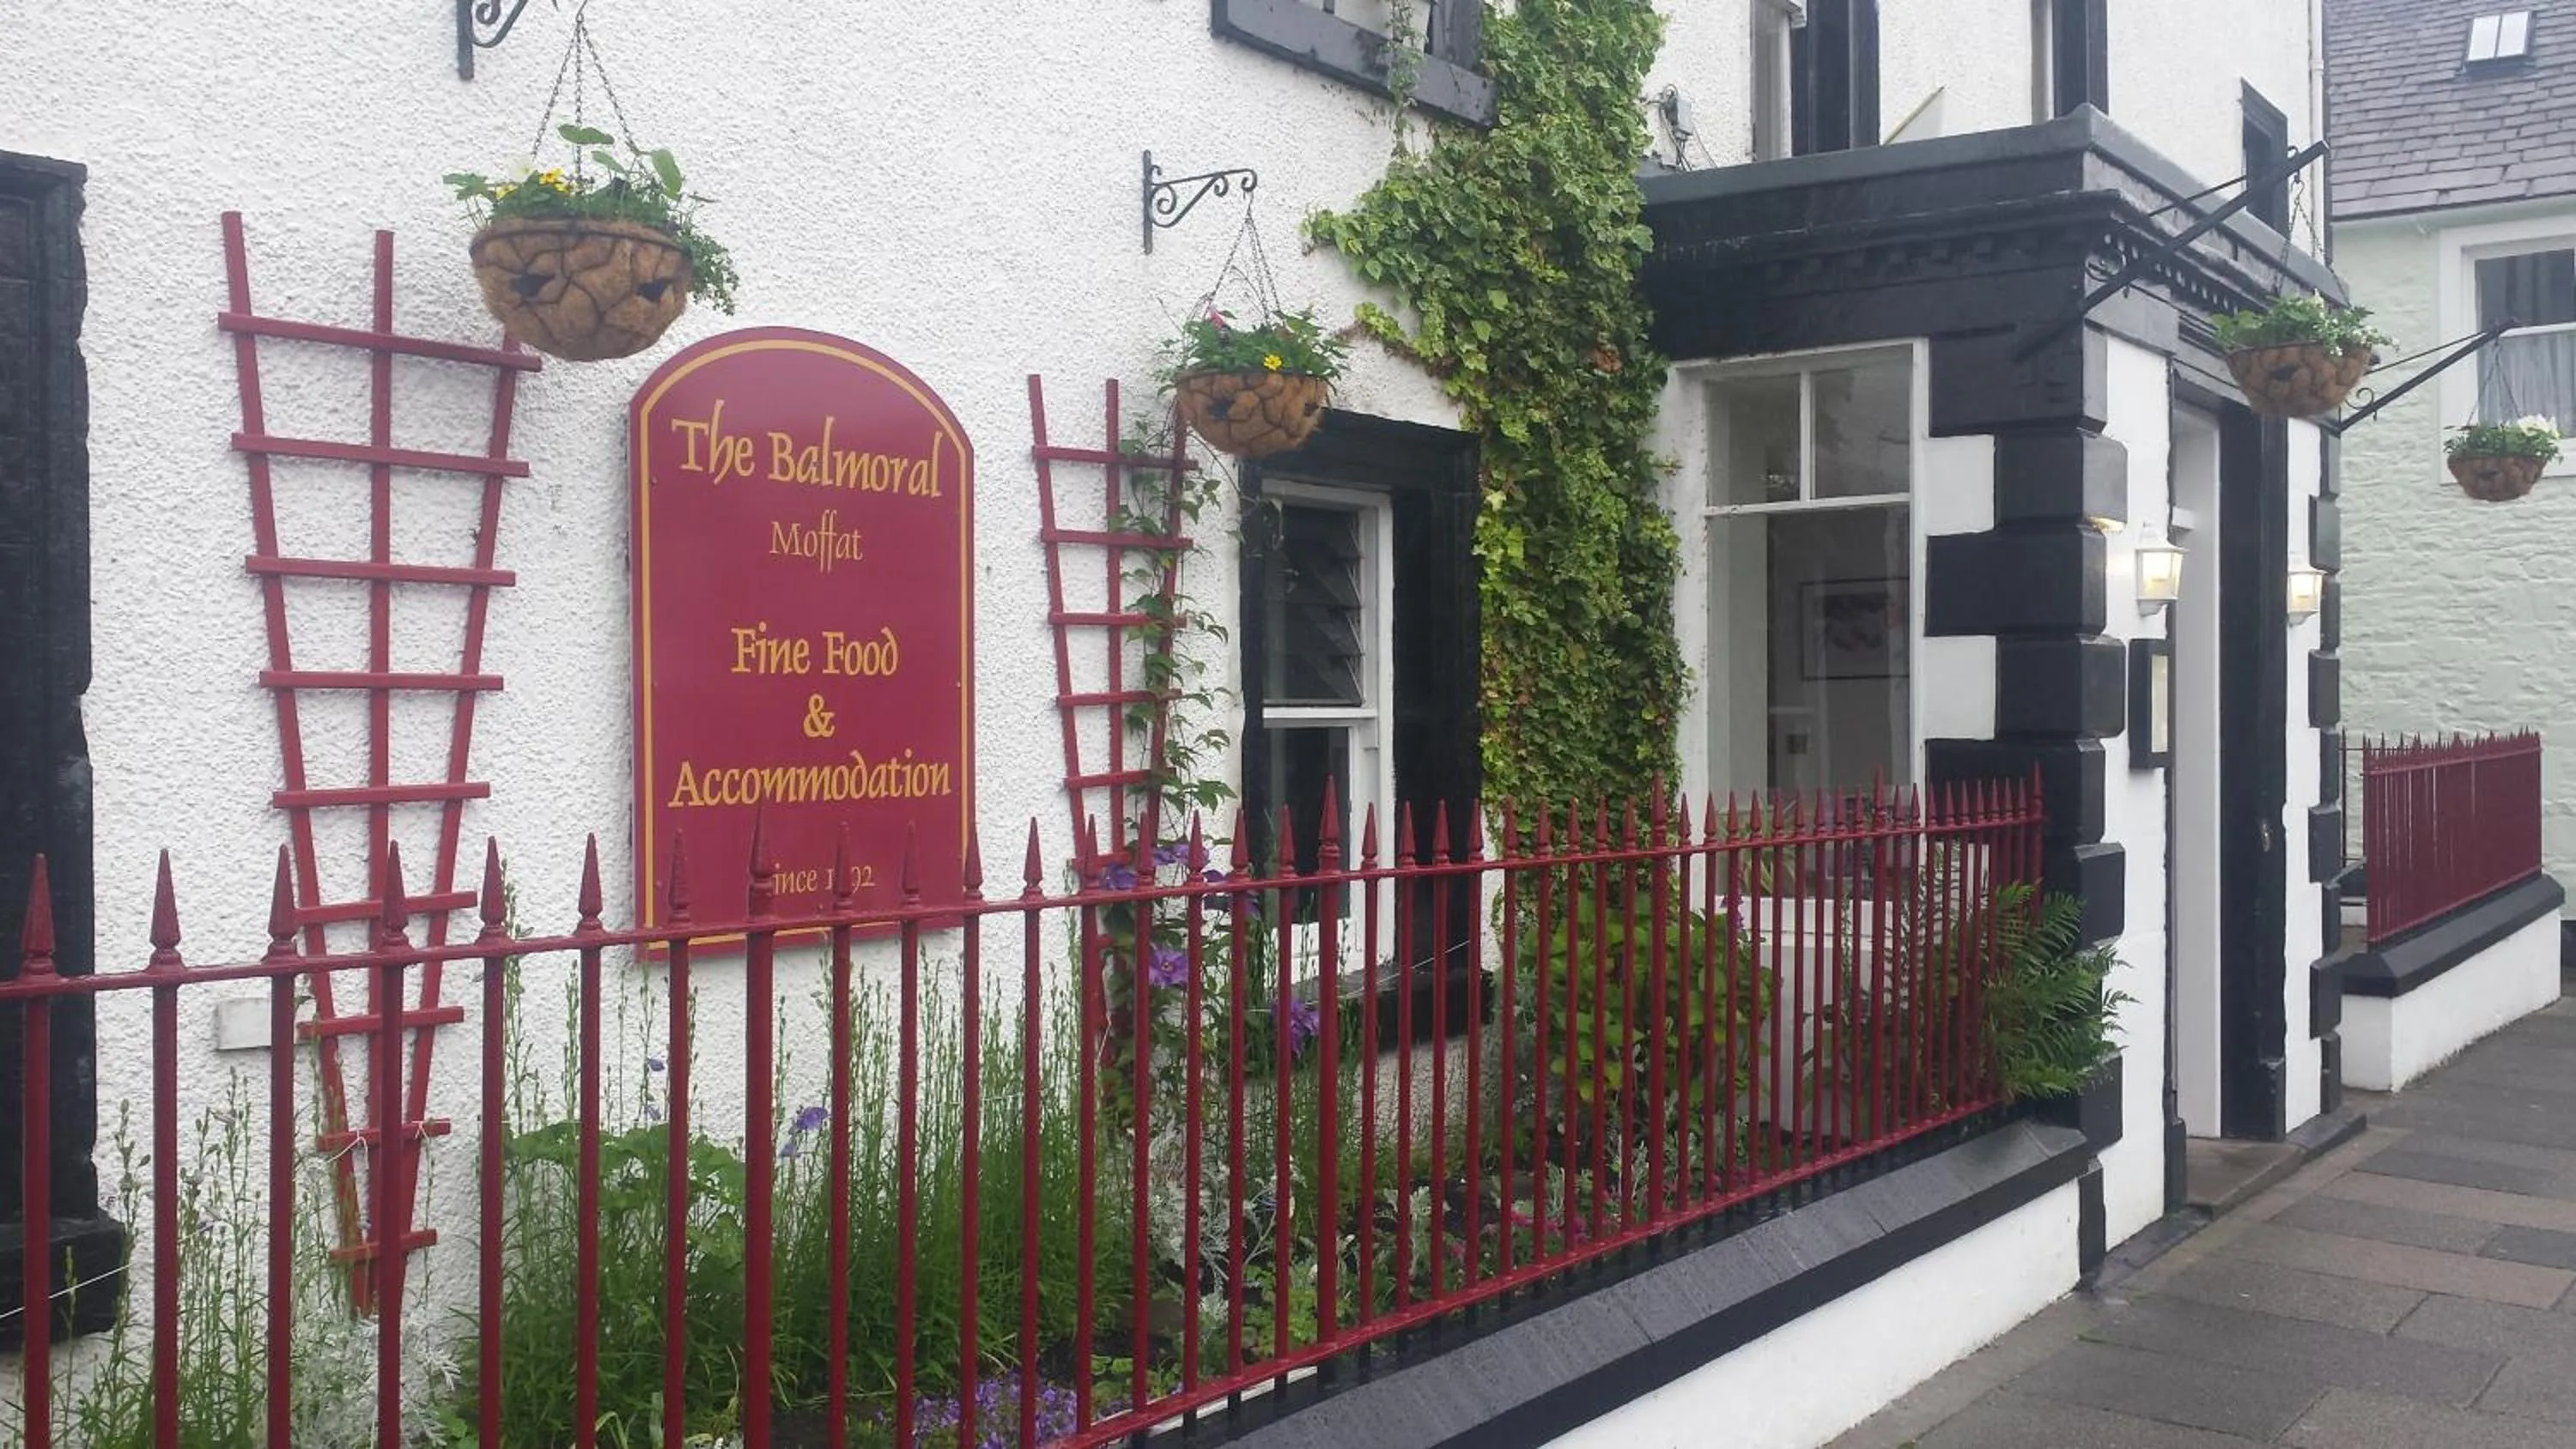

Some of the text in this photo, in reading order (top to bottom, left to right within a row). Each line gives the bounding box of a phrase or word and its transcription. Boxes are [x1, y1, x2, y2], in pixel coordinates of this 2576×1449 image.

[671, 399, 942, 497] The Balmoral
[769, 509, 862, 573] Moffat
[731, 621, 898, 676] Fine Food
[803, 694, 835, 737] &
[668, 749, 951, 807] Accommodation
[762, 862, 876, 895] ince 192
